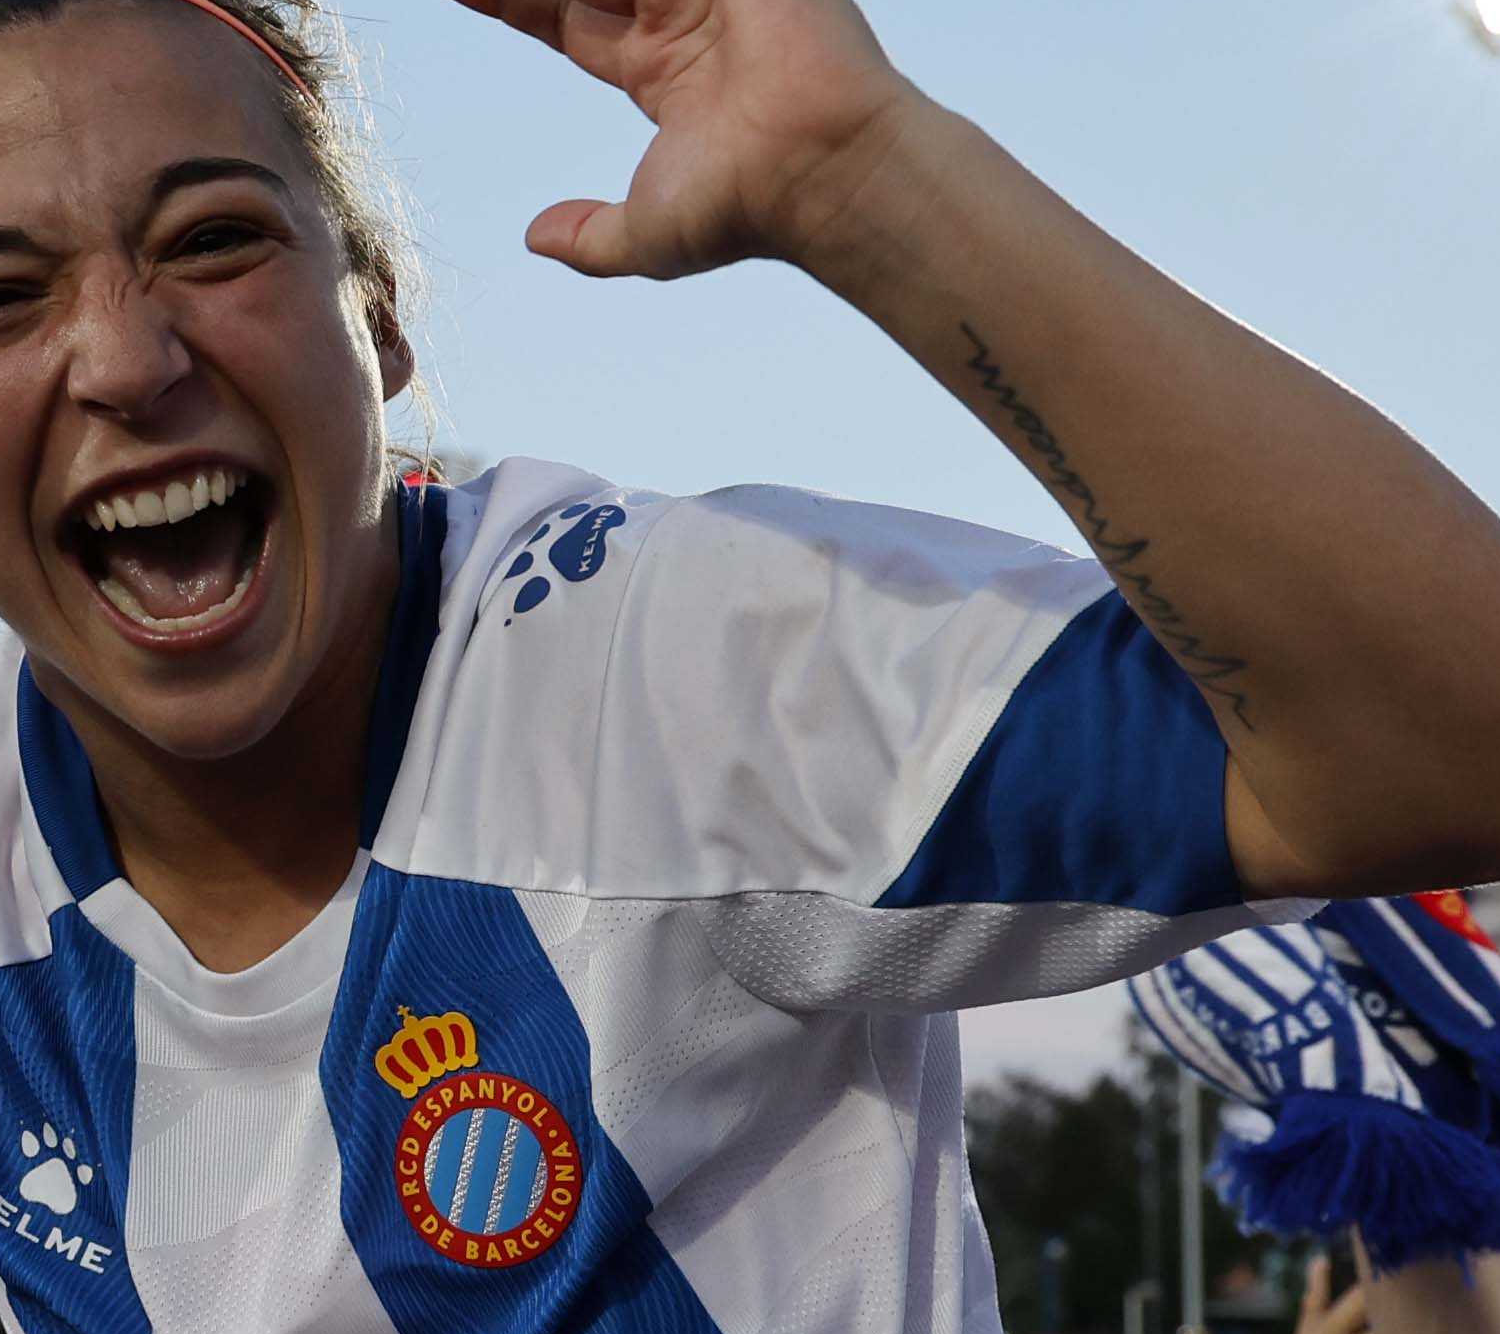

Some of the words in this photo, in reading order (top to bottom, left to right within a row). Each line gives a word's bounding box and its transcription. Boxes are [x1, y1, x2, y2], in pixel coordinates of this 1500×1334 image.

[577, 508, 617, 573] KELME
[399, 1136, 421, 1198] RCD
[412, 1078, 549, 1132] ESPANYOL
[420, 1214, 455, 1250] DE
[465, 1140, 576, 1262] BARCELONA
